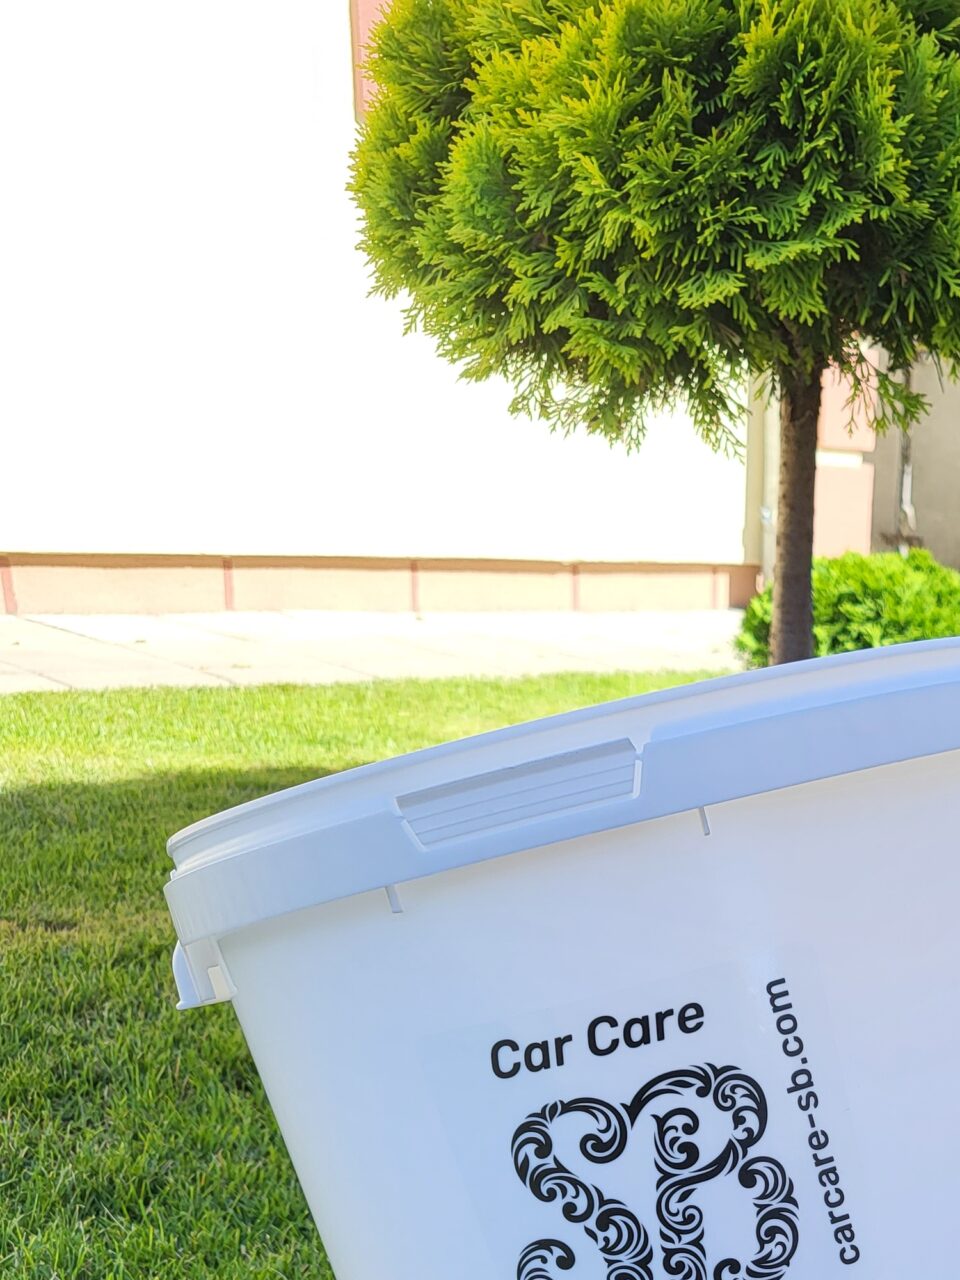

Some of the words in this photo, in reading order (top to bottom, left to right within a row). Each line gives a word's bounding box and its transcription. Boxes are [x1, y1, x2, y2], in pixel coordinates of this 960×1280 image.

[490, 1033, 573, 1080] Car
[586, 1002, 705, 1057] Care
[765, 976, 861, 1266] carcare-sb.com
